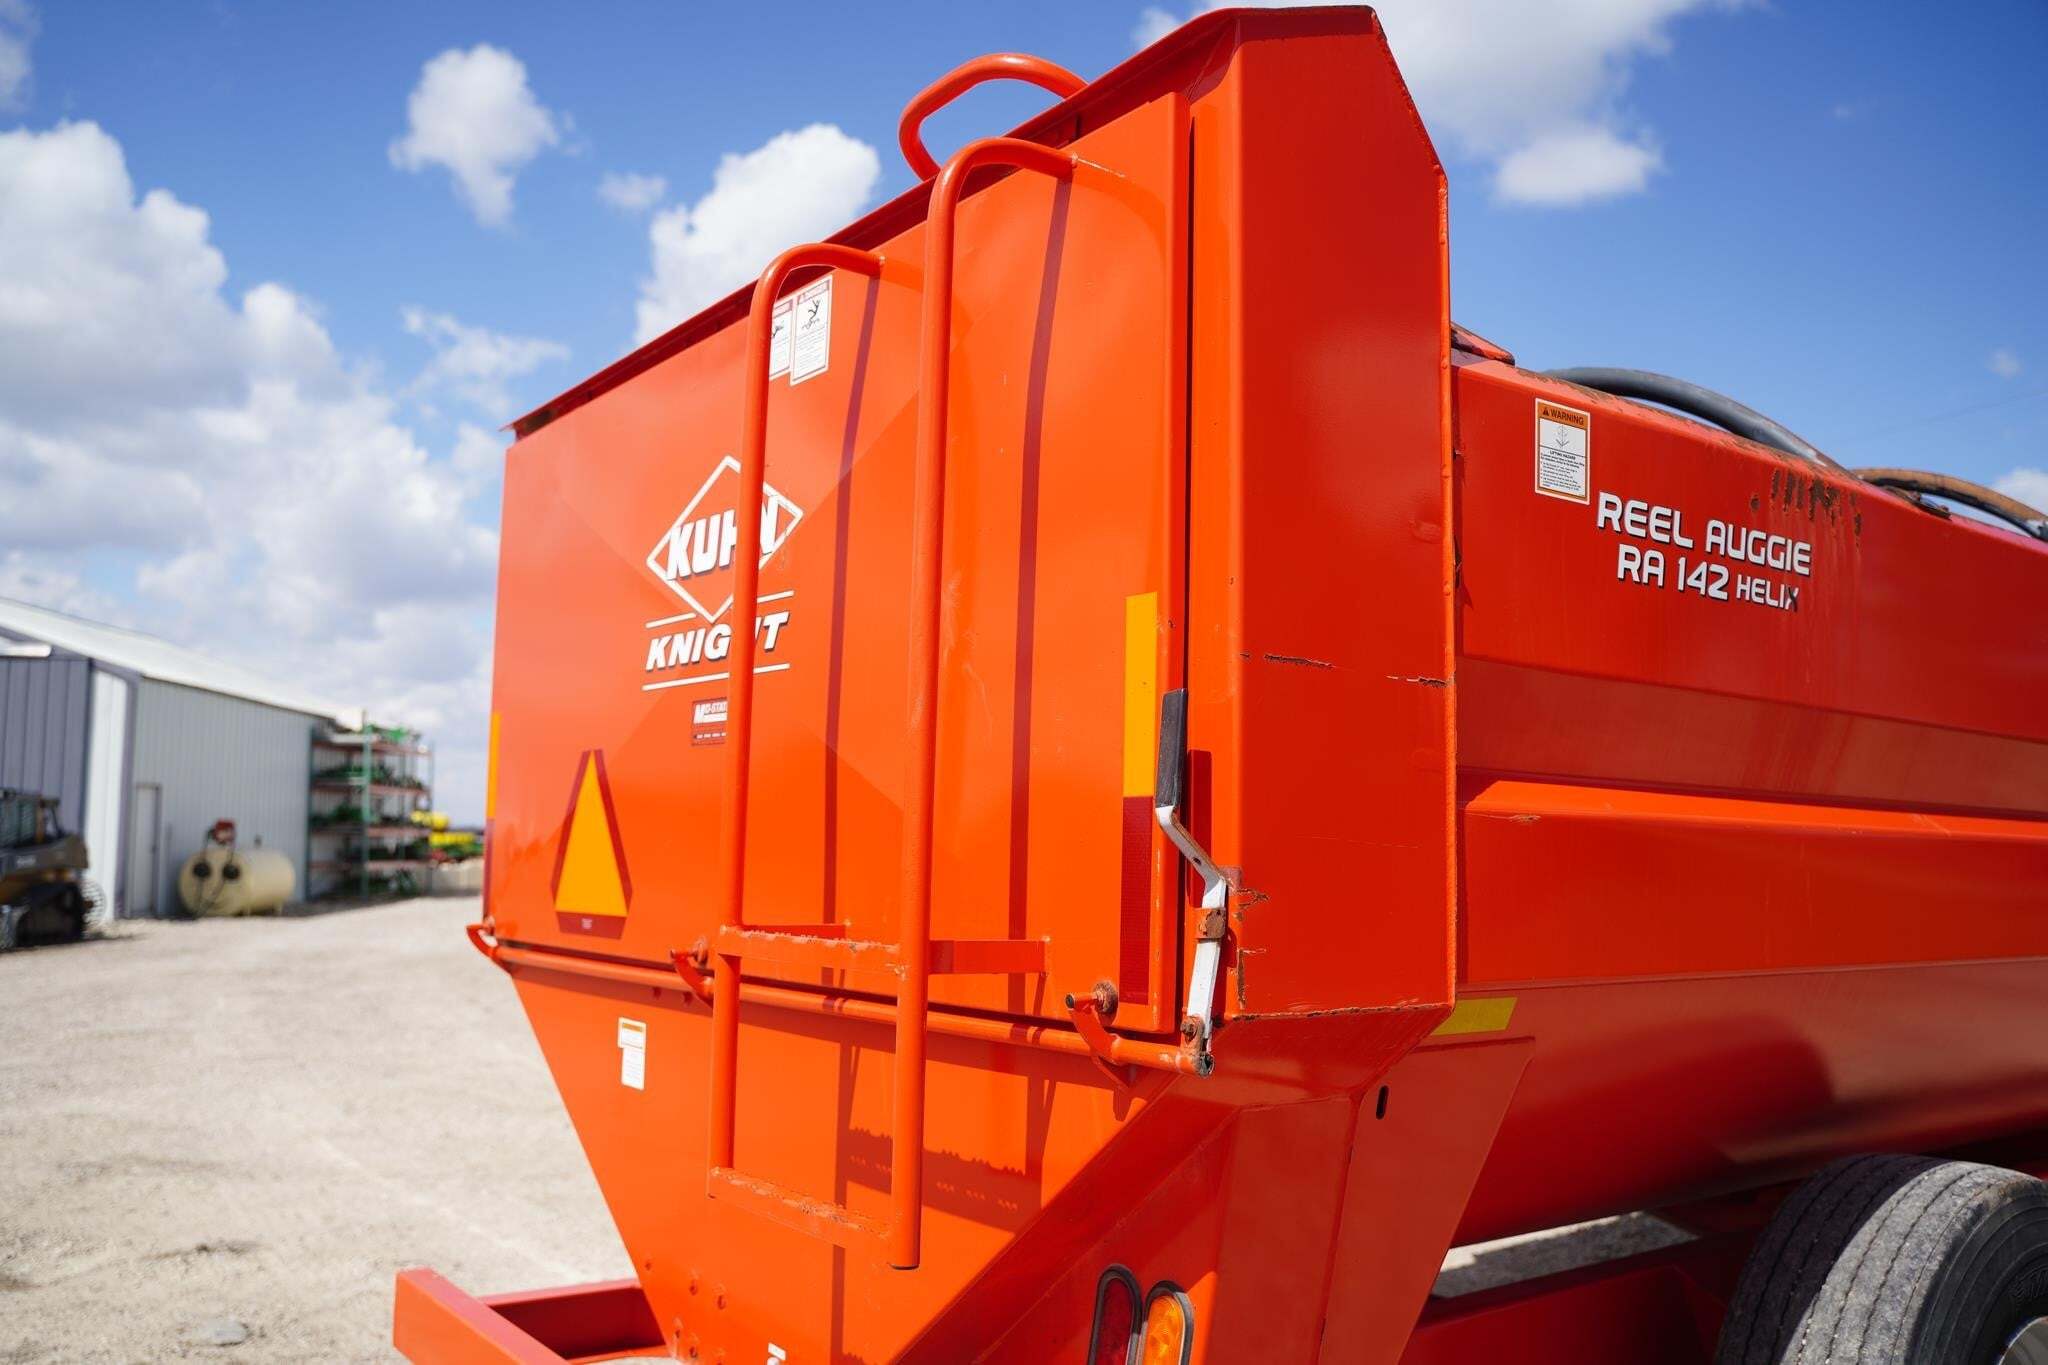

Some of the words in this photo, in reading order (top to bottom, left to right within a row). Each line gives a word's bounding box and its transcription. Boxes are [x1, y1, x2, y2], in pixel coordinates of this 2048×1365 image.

[1550, 408, 1584, 425] WARNING
[1597, 491, 1694, 549] REEL
[1705, 519, 1812, 575] AUGGIE
[1617, 543, 1665, 586] RA
[1677, 556, 1730, 600] 142
[1736, 574, 1799, 610] HELIX
[645, 611, 790, 671] KNIGT
